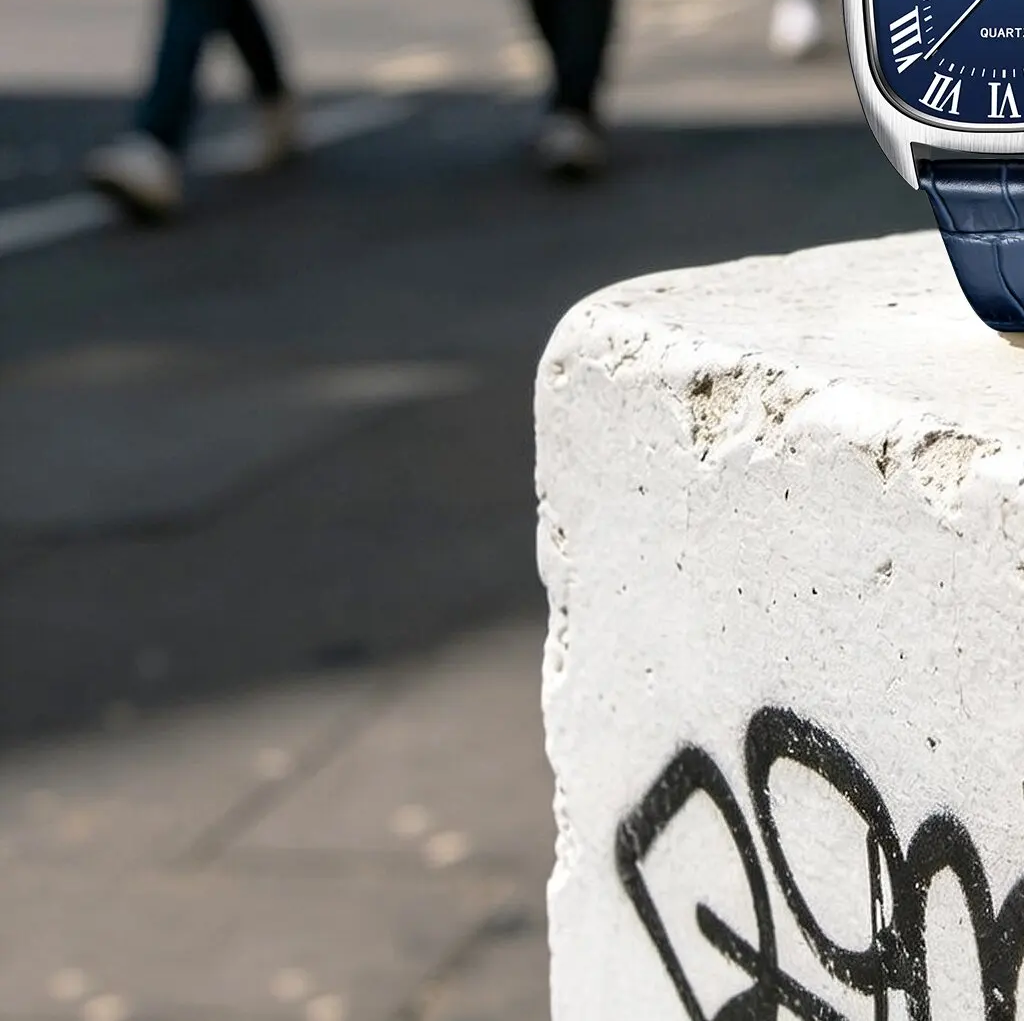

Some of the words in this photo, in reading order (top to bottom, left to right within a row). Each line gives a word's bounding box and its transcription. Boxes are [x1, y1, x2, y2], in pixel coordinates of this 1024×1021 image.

[889, 5, 923, 74] VIII
[919, 72, 962, 115] VII
[987, 82, 1022, 118] VI
